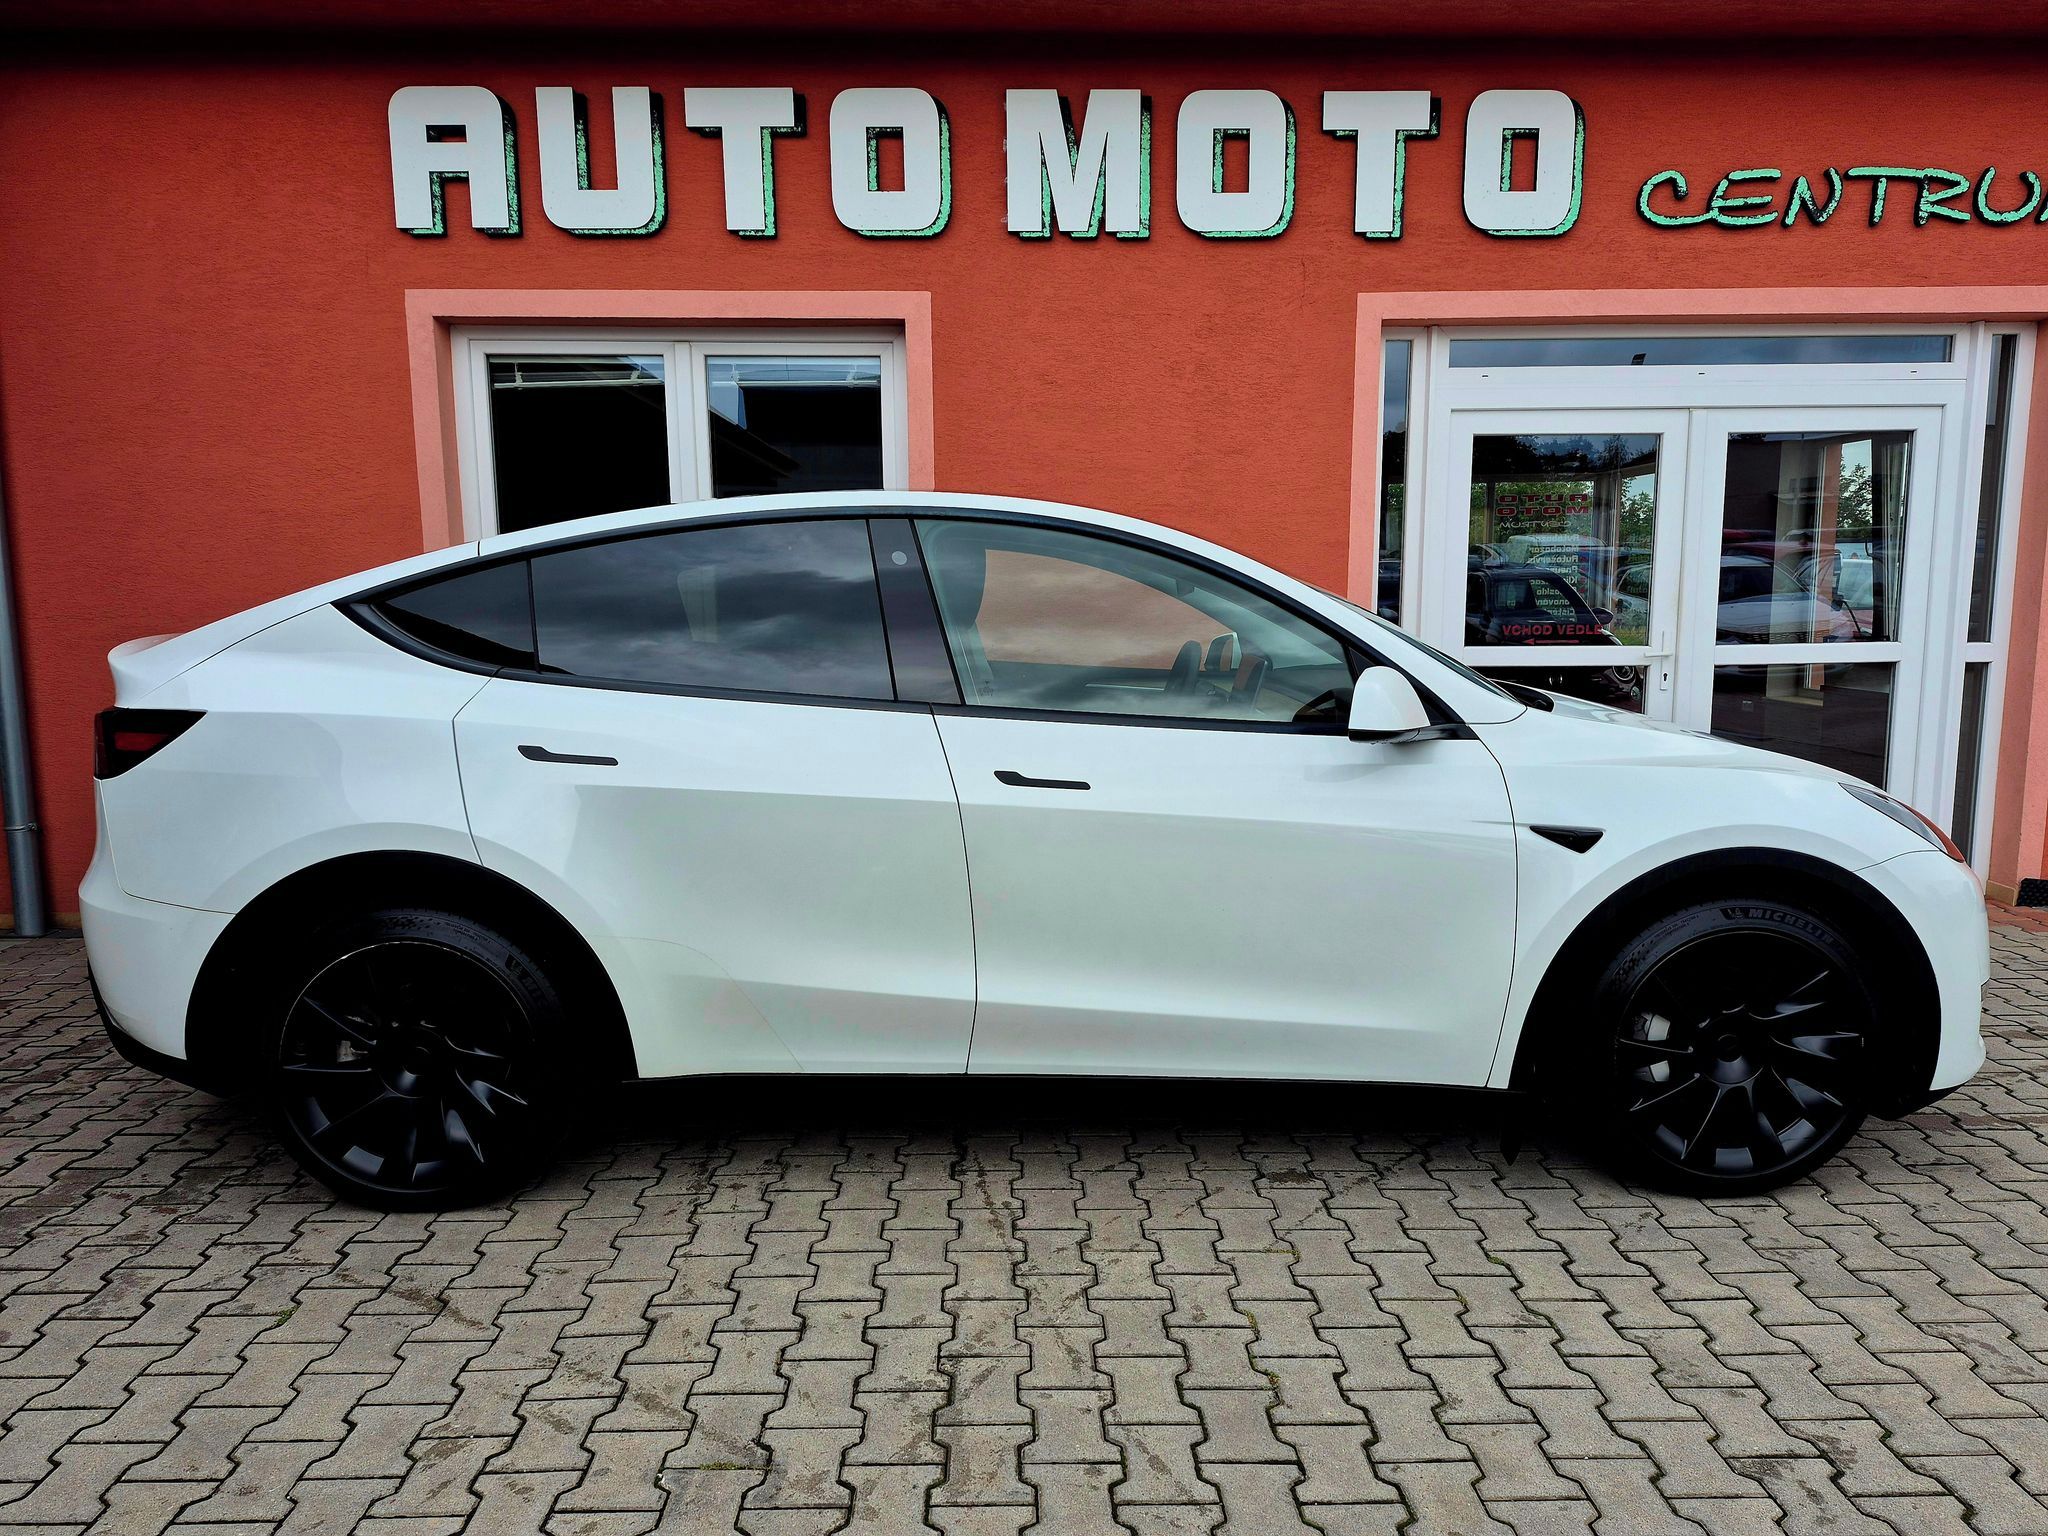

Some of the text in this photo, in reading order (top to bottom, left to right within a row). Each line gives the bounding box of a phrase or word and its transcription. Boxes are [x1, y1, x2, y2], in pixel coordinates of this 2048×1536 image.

[388, 85, 2048, 239] AUTO MOTO CENTRU
[1502, 624, 1553, 636] VCHOD
[1748, 908, 1835, 945] MICHELIN
